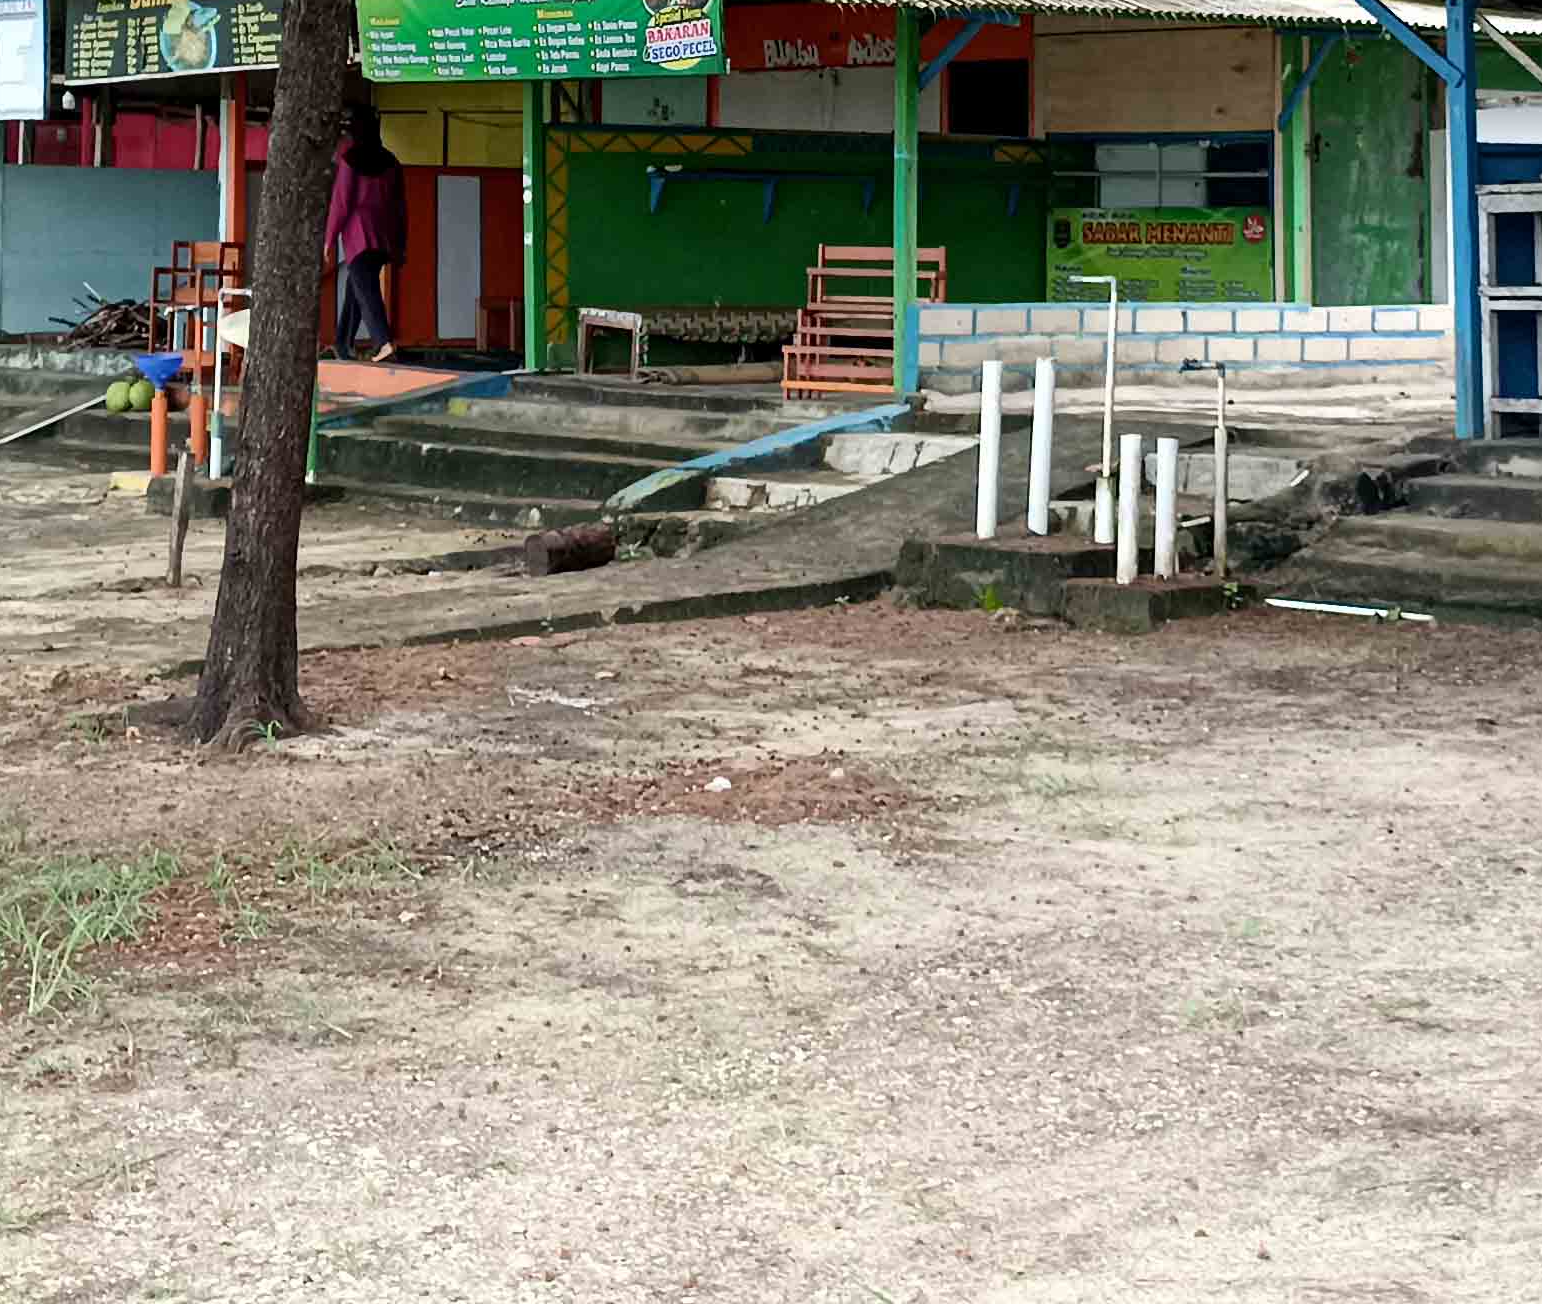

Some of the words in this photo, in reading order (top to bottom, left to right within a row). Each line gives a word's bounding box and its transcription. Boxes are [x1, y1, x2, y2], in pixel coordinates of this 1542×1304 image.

[646, 21, 709, 43] BAKARAN
[651, 44, 681, 60] SEGO
[682, 39, 715, 56] PECEL
